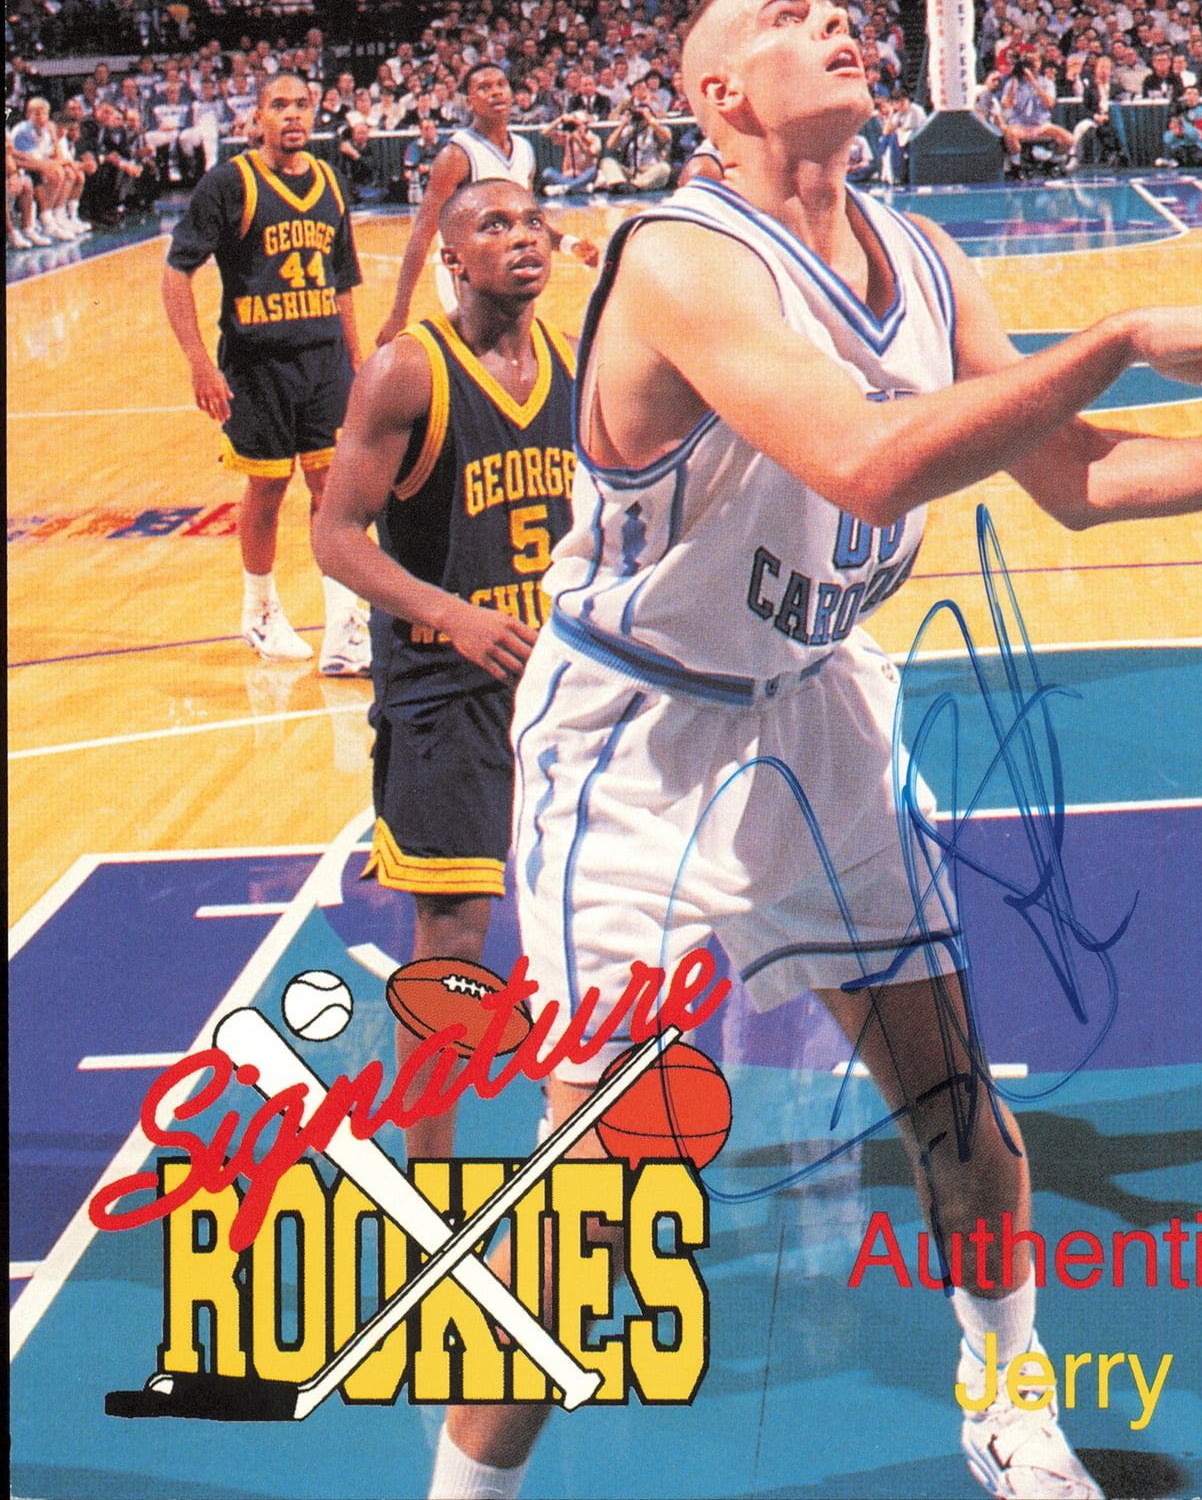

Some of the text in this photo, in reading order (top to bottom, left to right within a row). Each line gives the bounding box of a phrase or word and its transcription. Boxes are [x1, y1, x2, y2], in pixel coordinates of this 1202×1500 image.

[263, 219, 336, 257] GEORGE
[279, 250, 327, 289] 44
[464, 446, 578, 518] GEORGE
[510, 504, 552, 574] 5
